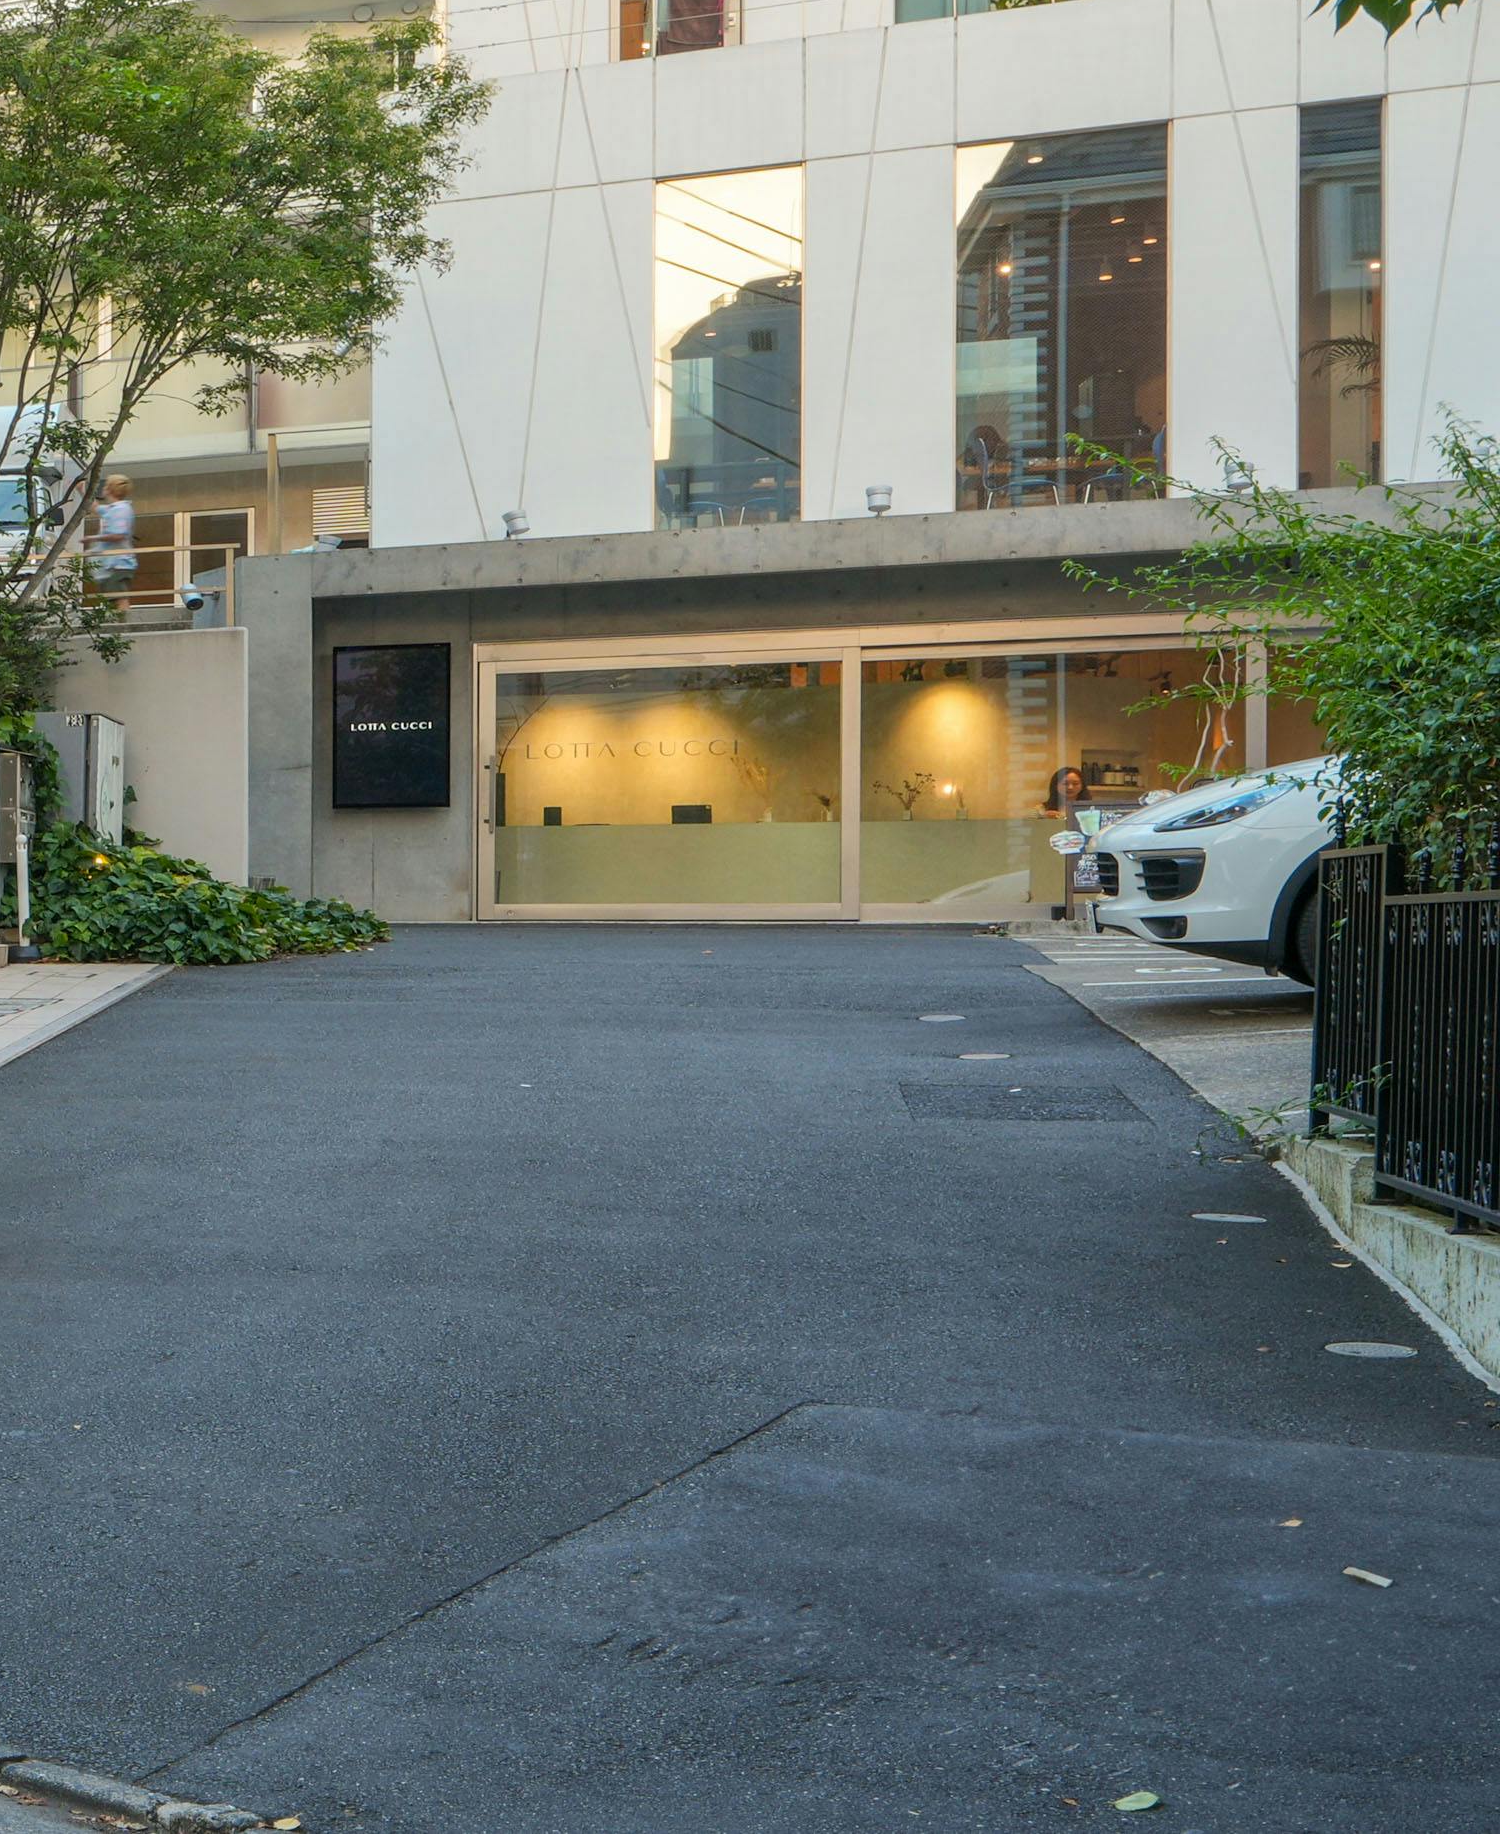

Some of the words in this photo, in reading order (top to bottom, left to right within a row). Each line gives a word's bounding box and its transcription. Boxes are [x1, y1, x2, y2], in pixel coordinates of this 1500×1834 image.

[350, 723, 387, 732] LOTTA
[391, 721, 433, 731] CUCCI
[526, 742, 616, 760] LOTTA
[634, 739, 739, 757] CUCCI
